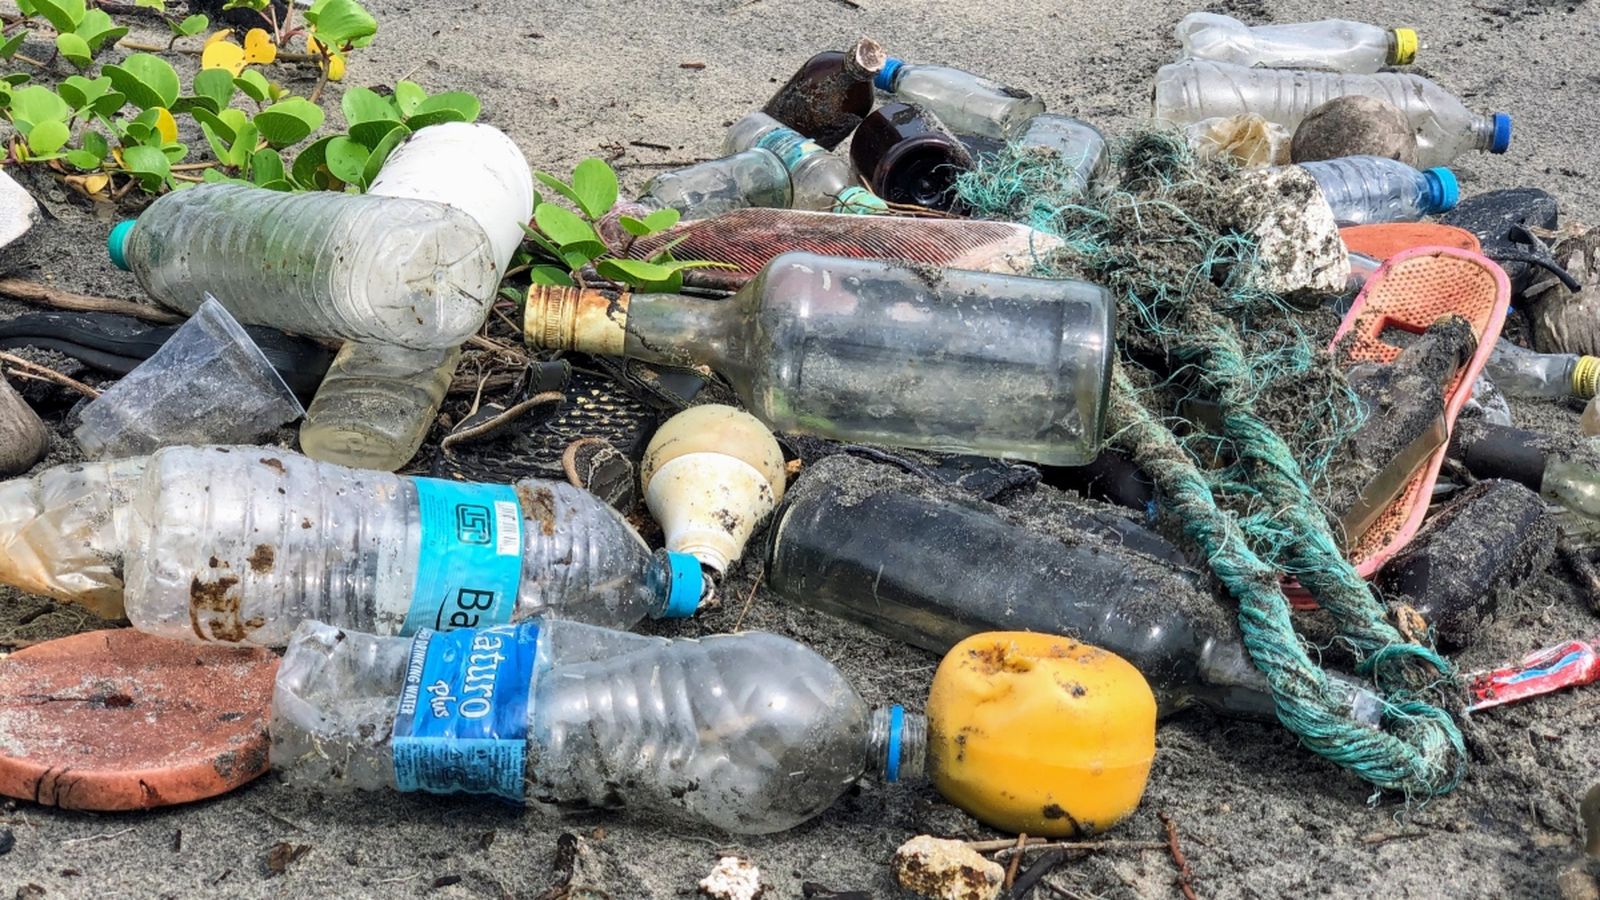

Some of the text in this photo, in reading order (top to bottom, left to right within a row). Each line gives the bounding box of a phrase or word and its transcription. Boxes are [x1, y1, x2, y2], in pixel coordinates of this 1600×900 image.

[449, 588, 495, 630] Ba
[407, 639, 429, 685] DRINKING
[400, 686, 420, 715] WATER
[427, 680, 457, 719] plus
